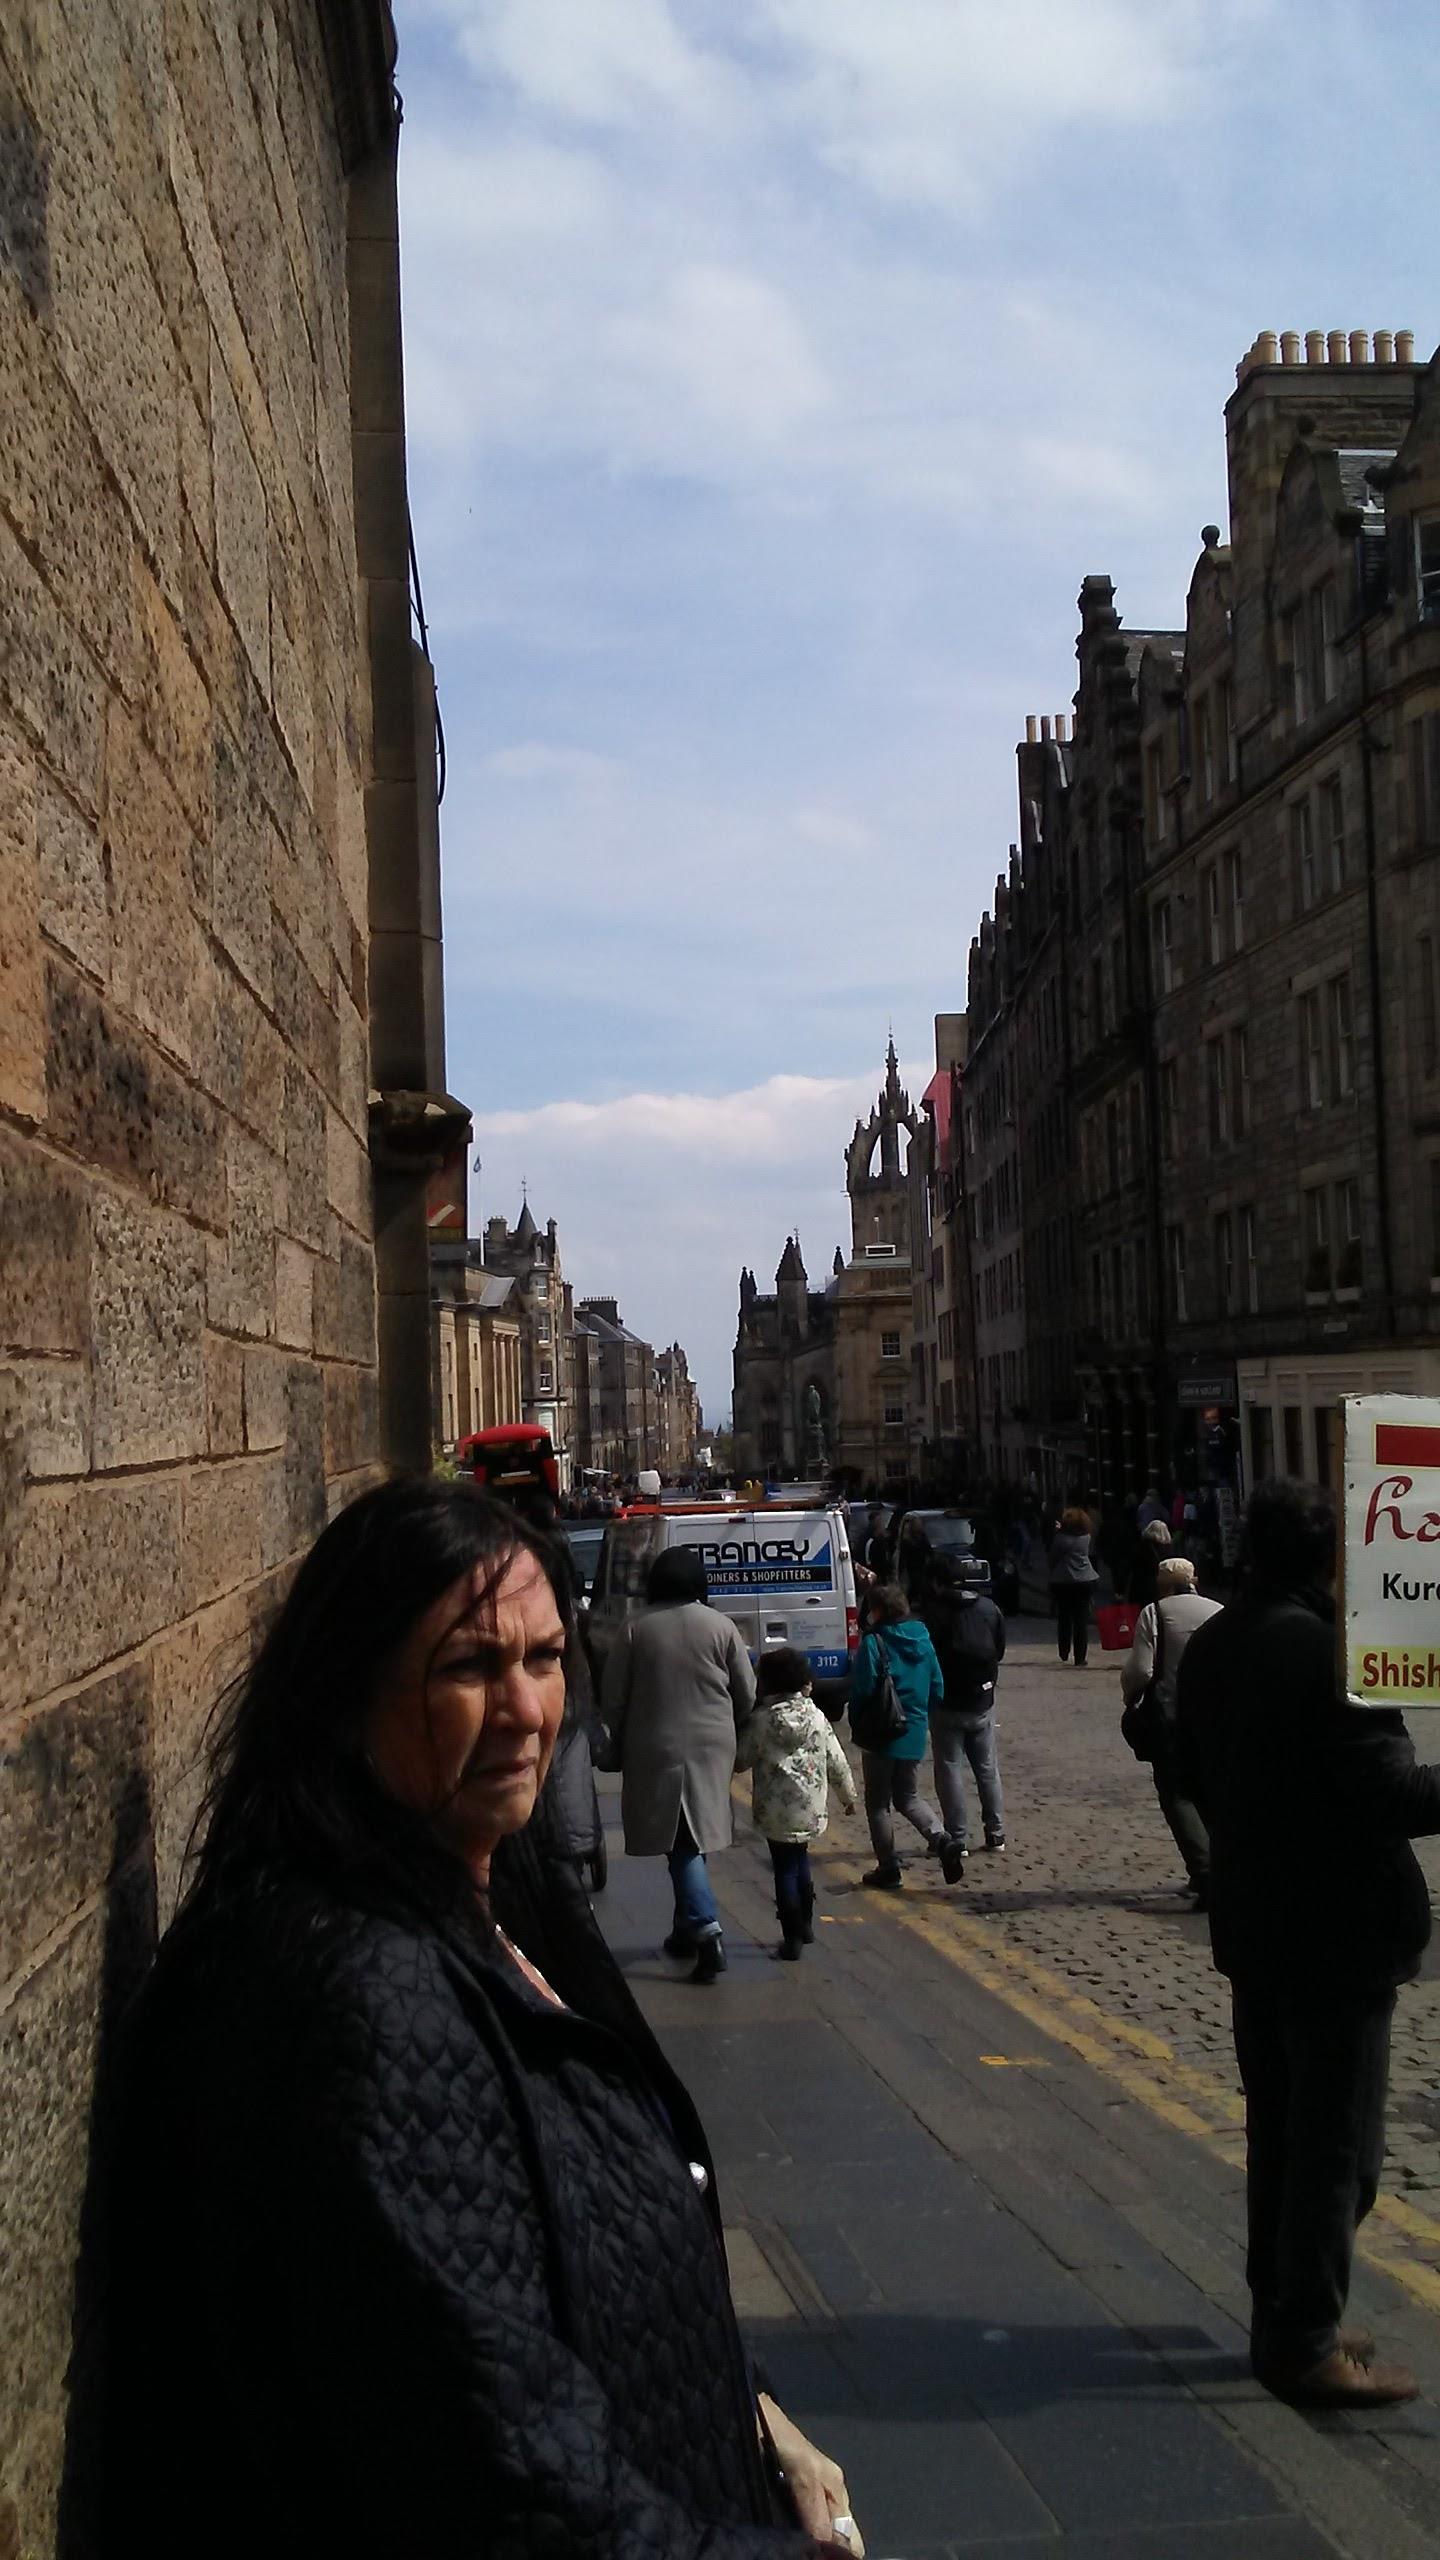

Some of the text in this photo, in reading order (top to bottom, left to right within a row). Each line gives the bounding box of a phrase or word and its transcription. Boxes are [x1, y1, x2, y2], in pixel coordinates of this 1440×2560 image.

[706, 1569, 811, 1583] OINERS & SHOPFITTERS
[1383, 1573, 1440, 1601] Kur
[817, 1656, 838, 1668] 3112
[1362, 1652, 1440, 1688] Shish
